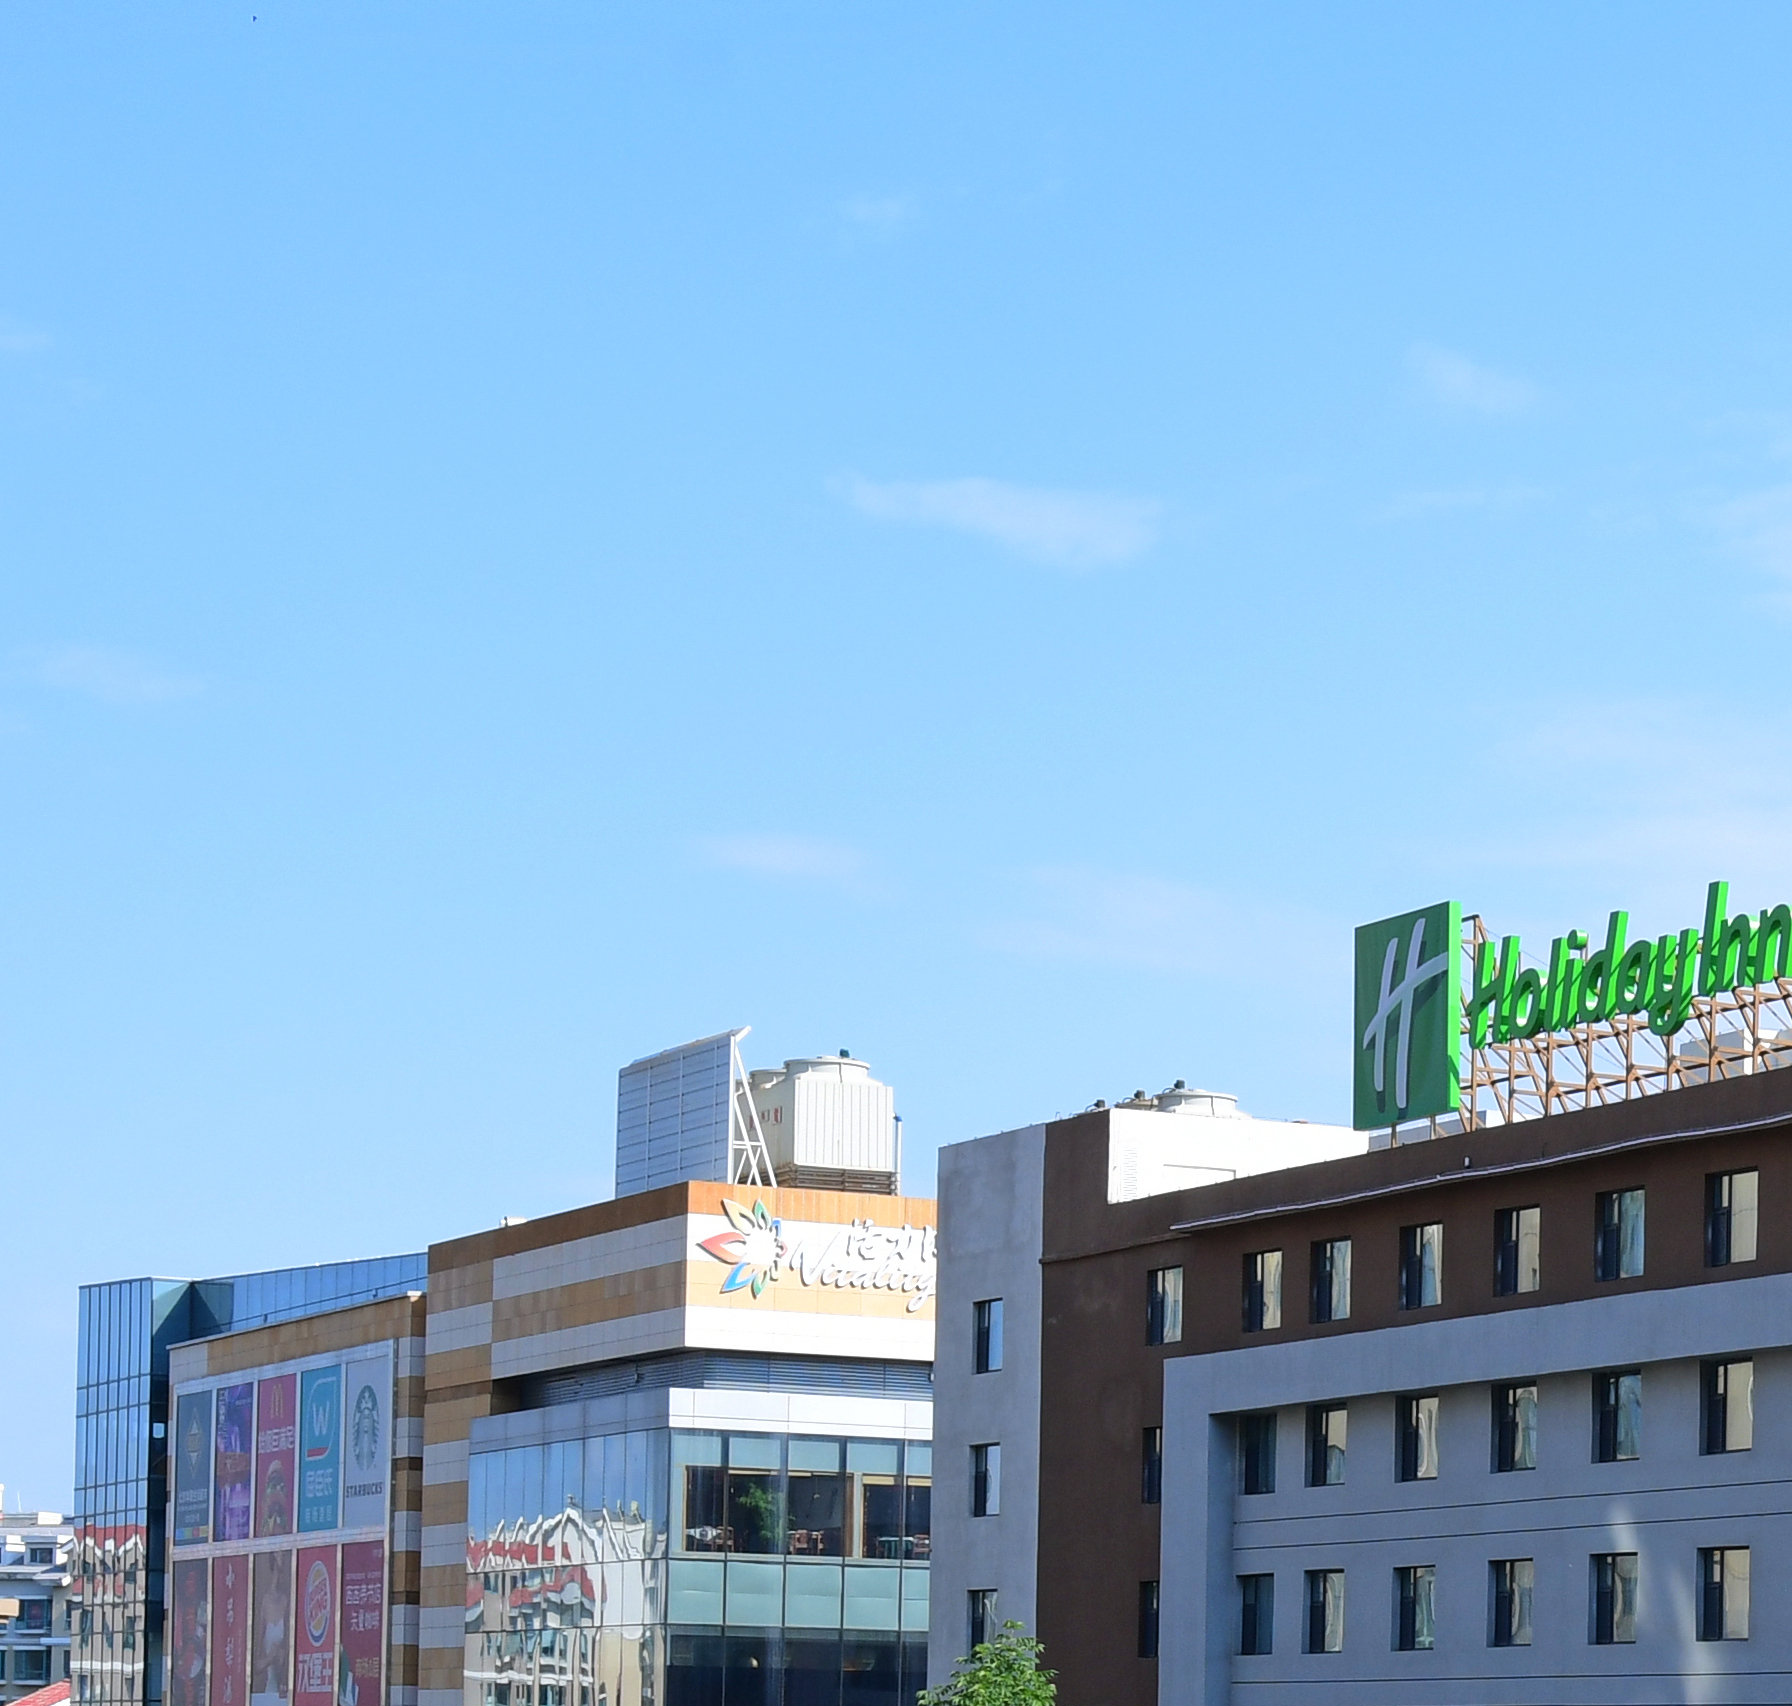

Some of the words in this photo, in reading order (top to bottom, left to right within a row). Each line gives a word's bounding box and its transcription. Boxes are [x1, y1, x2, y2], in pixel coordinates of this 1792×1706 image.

[1467, 910, 1697, 1050] Holiday
[789, 1231, 936, 1313] Vitality
[345, 1481, 383, 1498] STARBUCKS
[298, 1651, 333, 1693] 汉堡王
